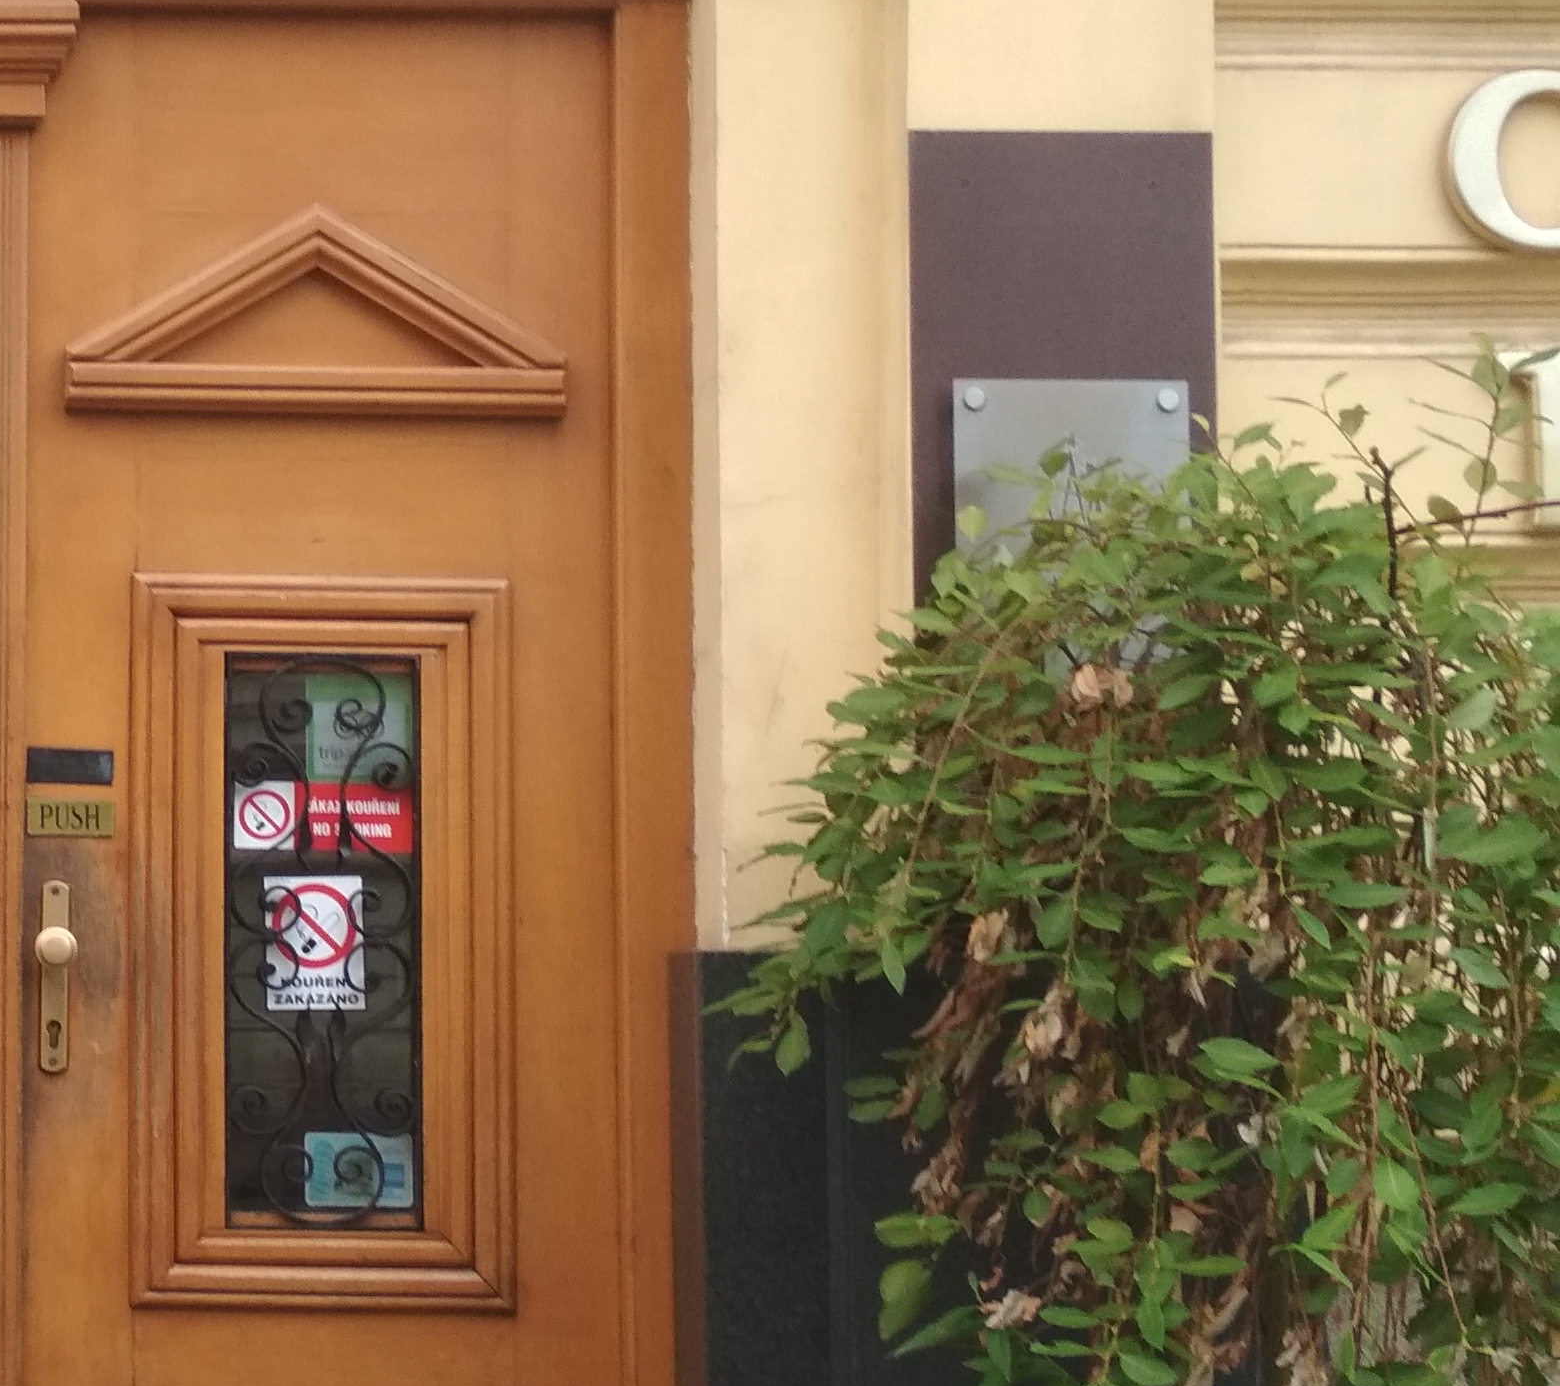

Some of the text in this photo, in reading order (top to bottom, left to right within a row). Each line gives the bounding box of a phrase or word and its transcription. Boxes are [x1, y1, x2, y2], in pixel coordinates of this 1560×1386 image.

[307, 796, 401, 816] ÁKAZ KOUŘENÍ
[39, 802, 101, 831] PUSH
[312, 821, 393, 839] NO SOKING
[281, 973, 348, 988] KOUŘEN
